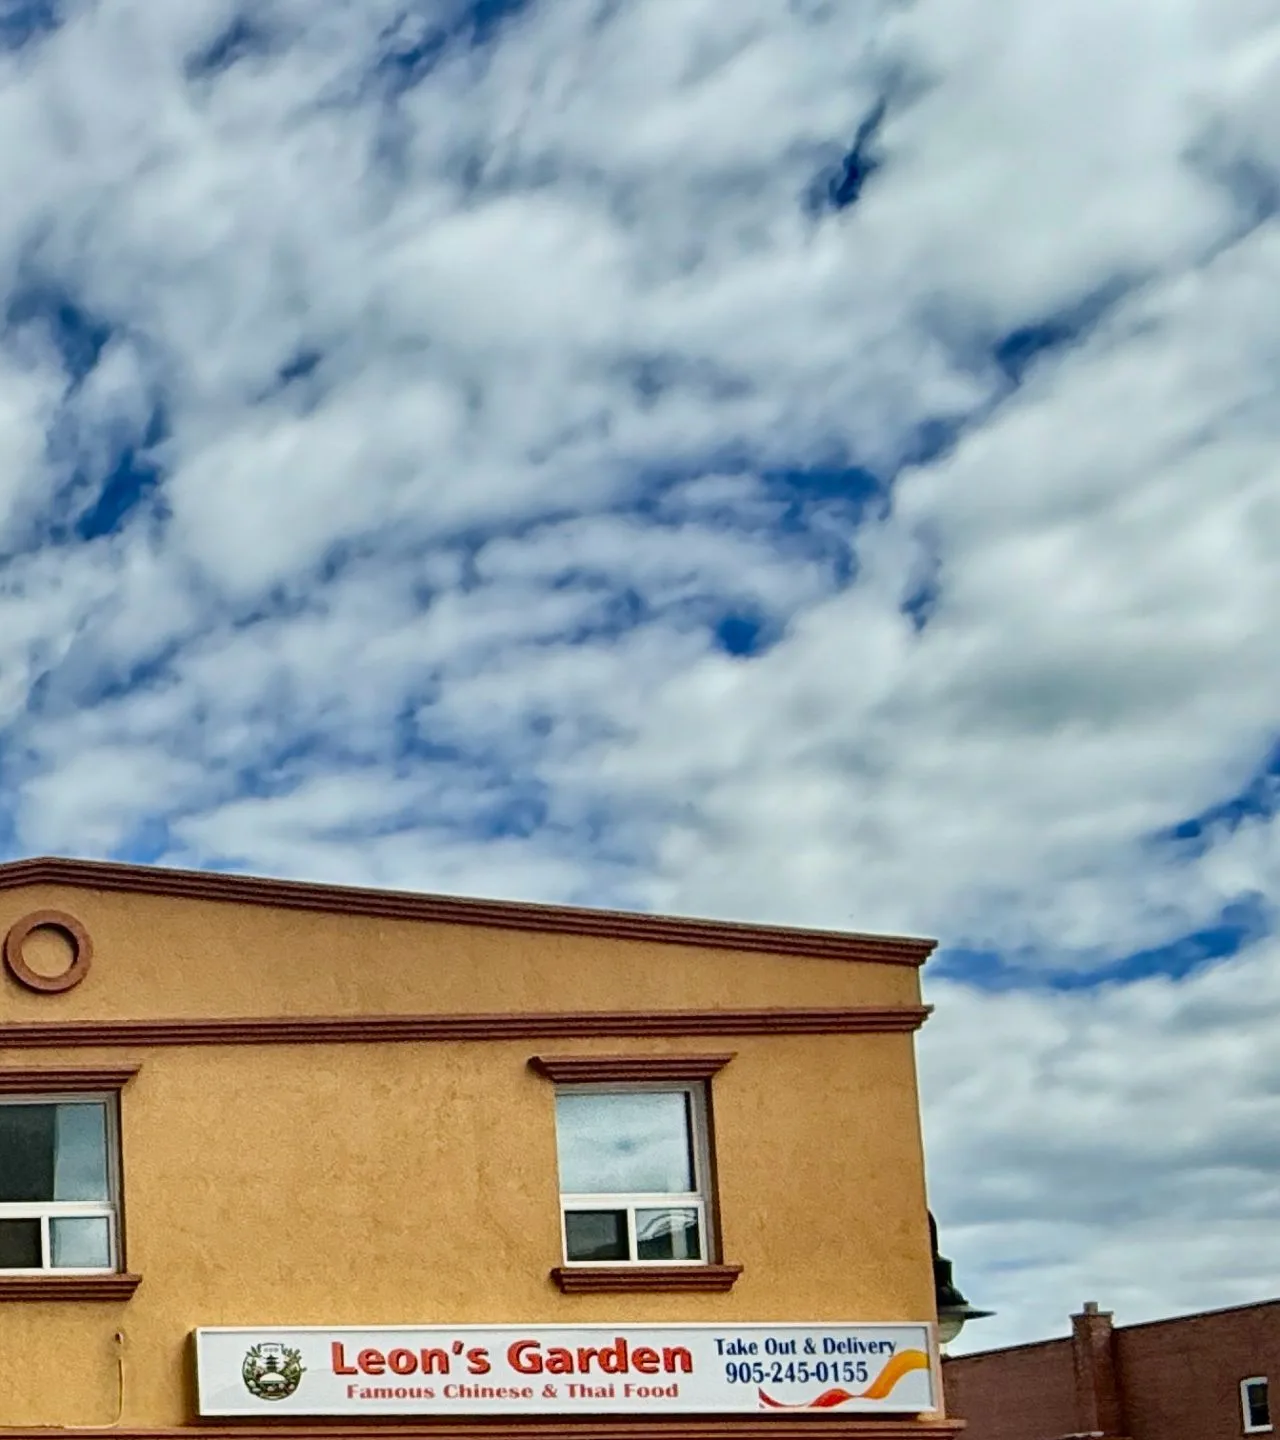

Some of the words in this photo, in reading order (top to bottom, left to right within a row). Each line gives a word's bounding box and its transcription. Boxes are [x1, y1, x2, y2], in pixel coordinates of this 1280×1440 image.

[330, 1341, 491, 1375] Leon's
[506, 1338, 694, 1375] Garden
[714, 1338, 758, 1356] Take
[764, 1338, 797, 1355] Out
[803, 1337, 816, 1354] &
[823, 1336, 897, 1357] Delivery
[725, 1361, 869, 1384] 905-245-0155
[346, 1384, 436, 1399] Famous
[442, 1383, 533, 1399] Chinese
[542, 1384, 558, 1398] &
[565, 1383, 616, 1399] Thai
[623, 1383, 679, 1398] Food
